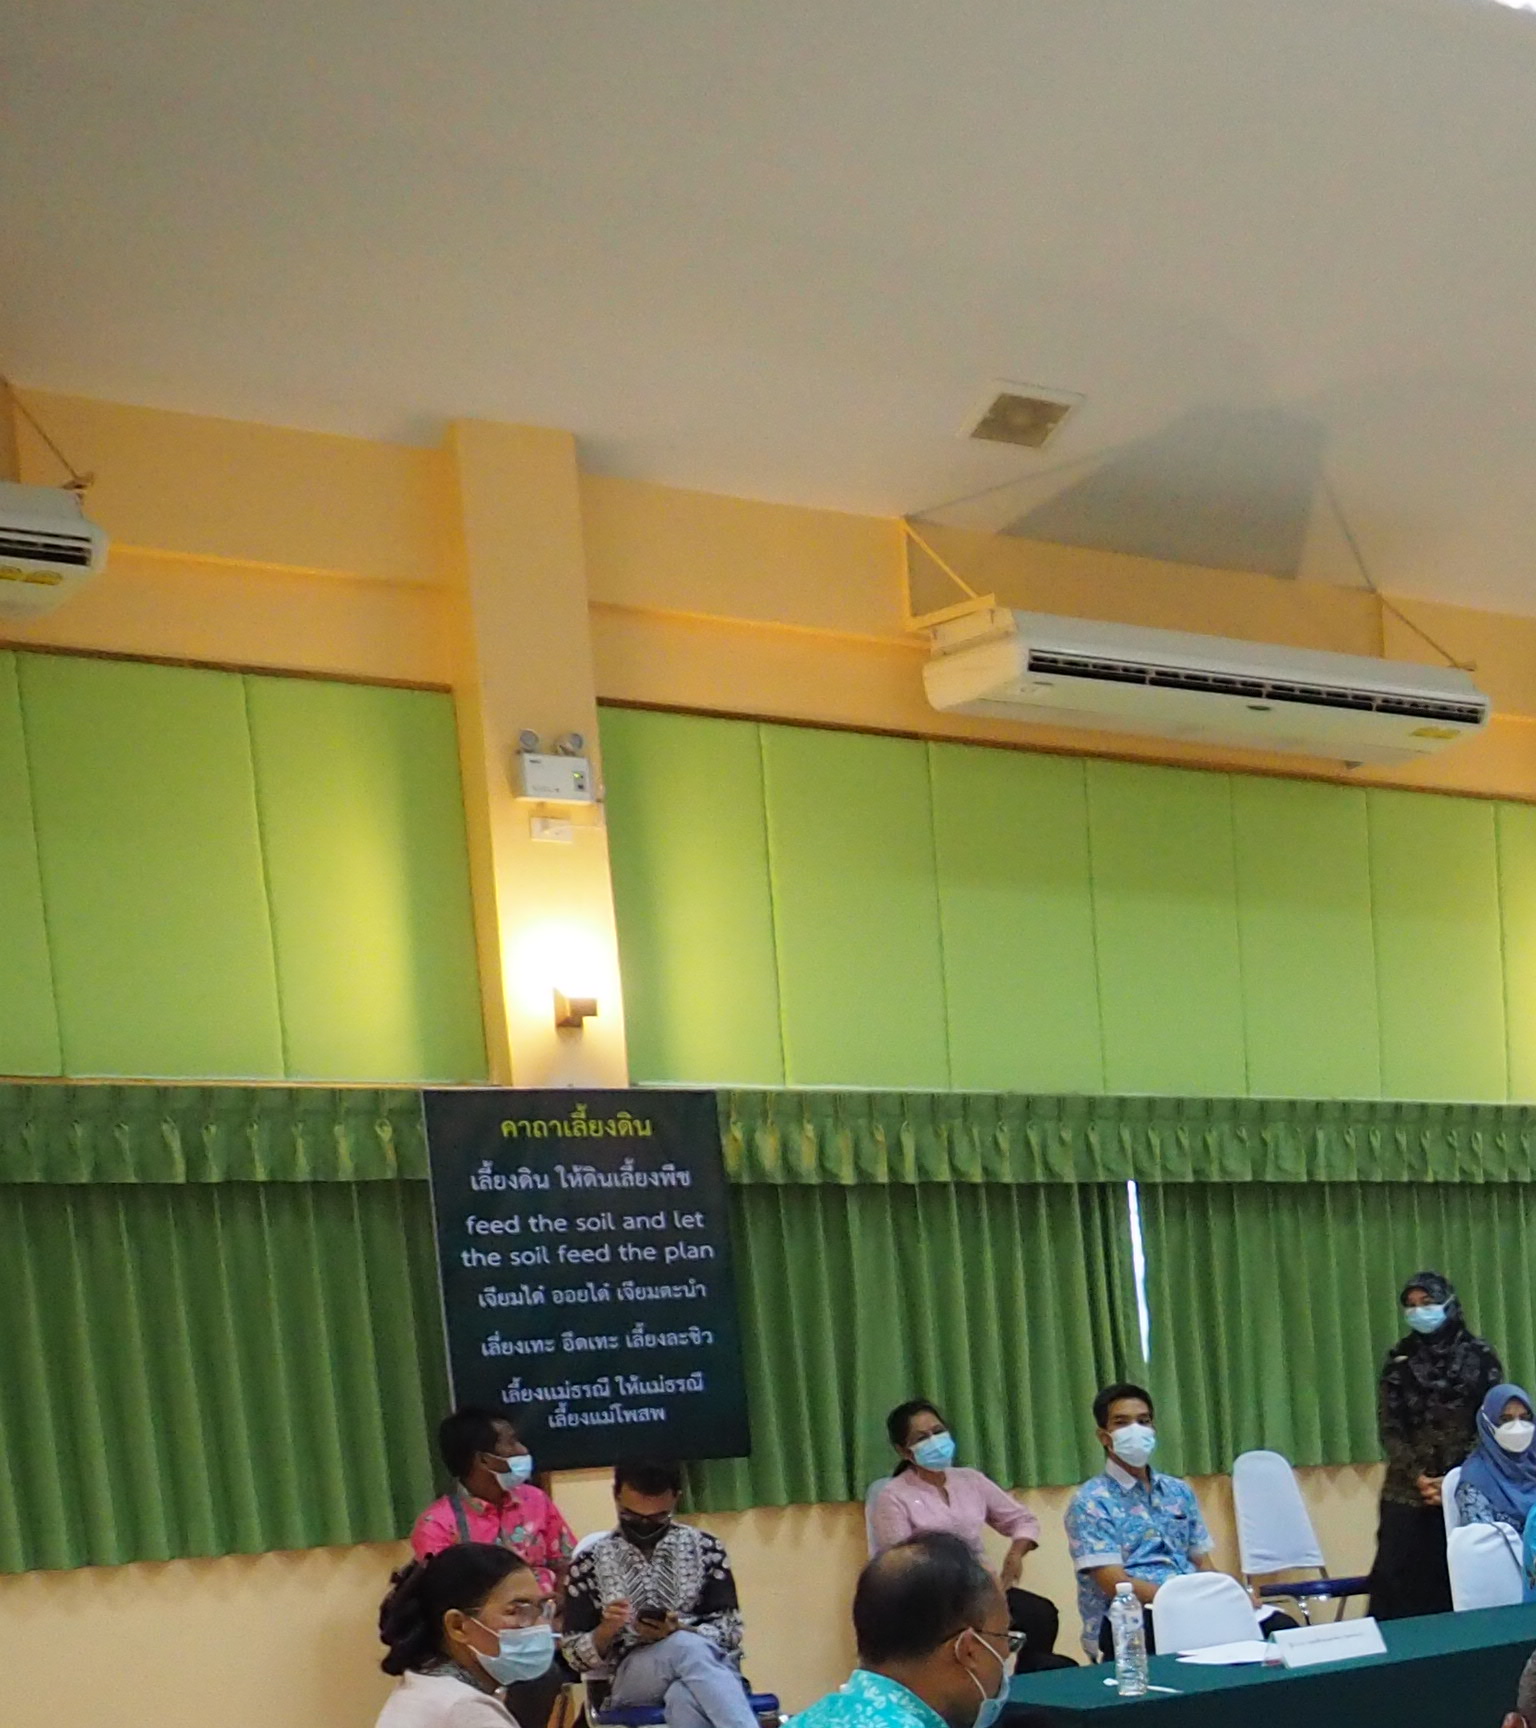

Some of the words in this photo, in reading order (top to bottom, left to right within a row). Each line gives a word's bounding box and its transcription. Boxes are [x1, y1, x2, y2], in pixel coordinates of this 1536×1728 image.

[470, 1160, 550, 1191] เลี้ยงดิน
[465, 1214, 520, 1234] feed
[528, 1214, 568, 1231] the
[576, 1212, 615, 1230] soil
[622, 1211, 665, 1229] and
[674, 1210, 705, 1228] let
[461, 1247, 501, 1267] the
[510, 1246, 550, 1265] soil
[558, 1244, 611, 1263] feed
[618, 1243, 657, 1260] the
[664, 1241, 714, 1264] plan
